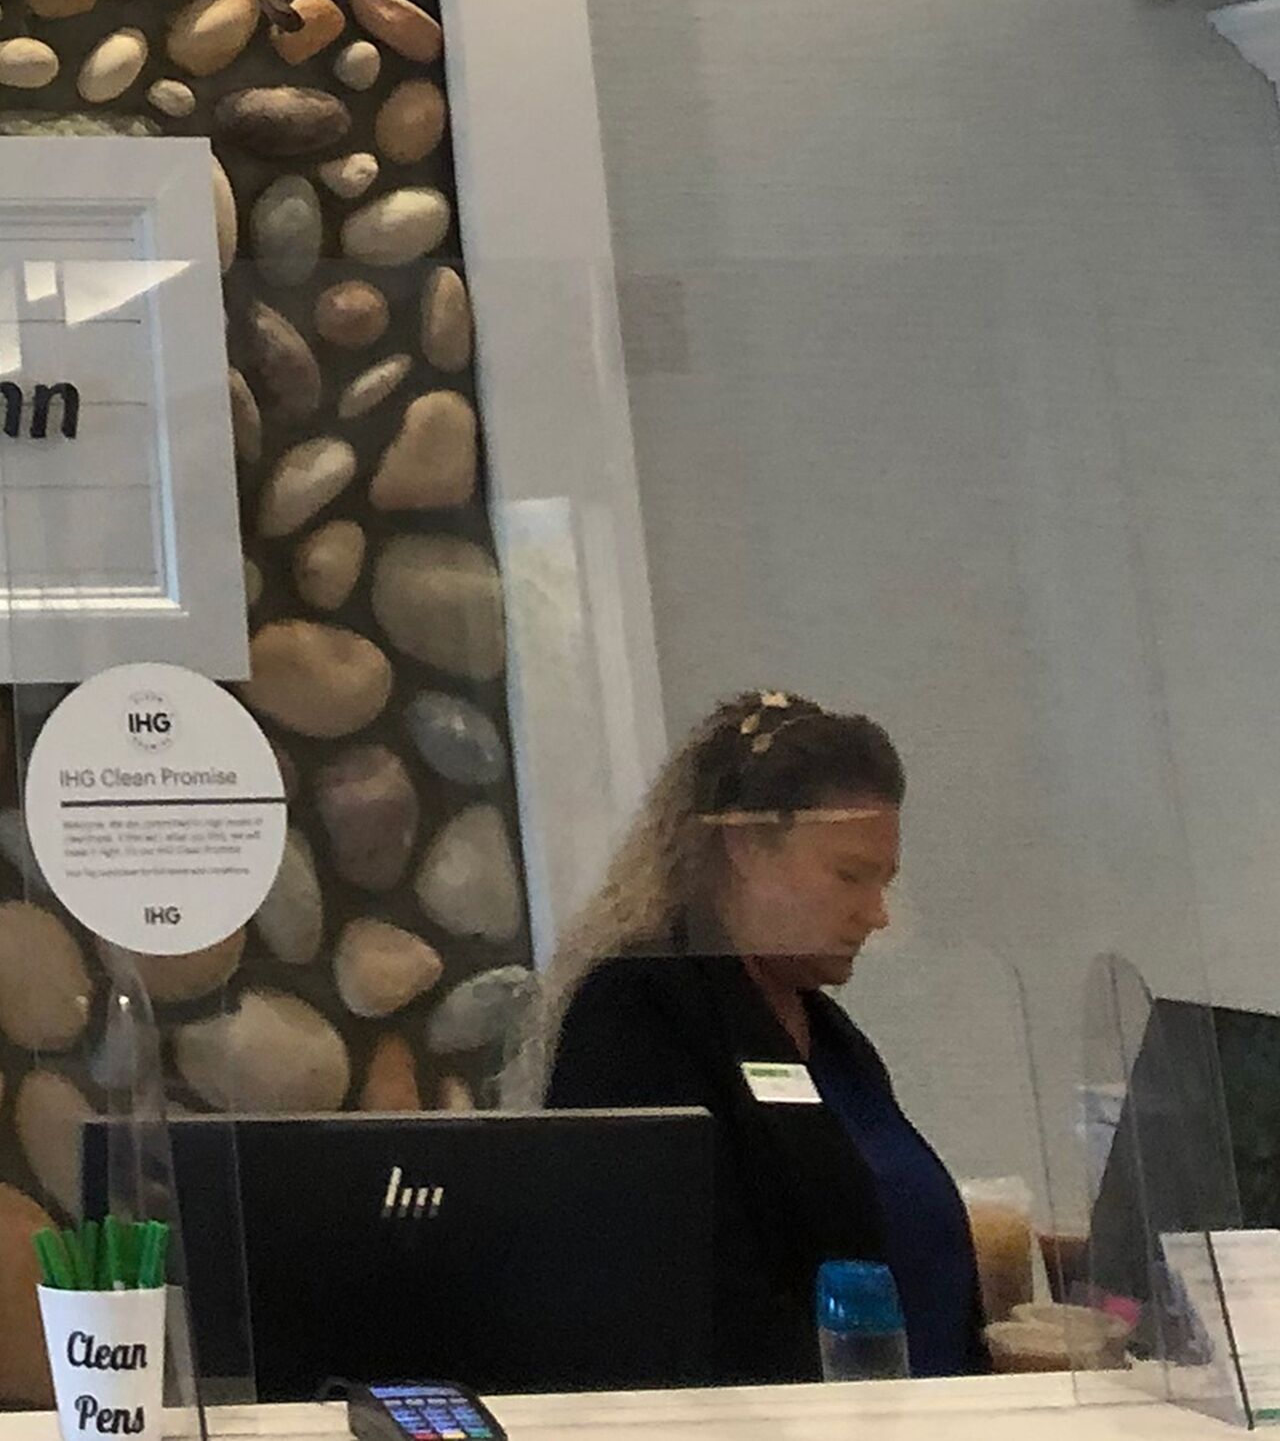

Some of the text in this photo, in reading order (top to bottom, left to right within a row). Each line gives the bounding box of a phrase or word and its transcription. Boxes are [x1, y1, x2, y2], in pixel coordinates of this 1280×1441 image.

[127, 712, 171, 734] IHG
[59, 766, 237, 788] IHG Clean Promise
[144, 906, 182, 926] IHG
[67, 1330, 148, 1372] Clean
[74, 1394, 146, 1435] Pens
